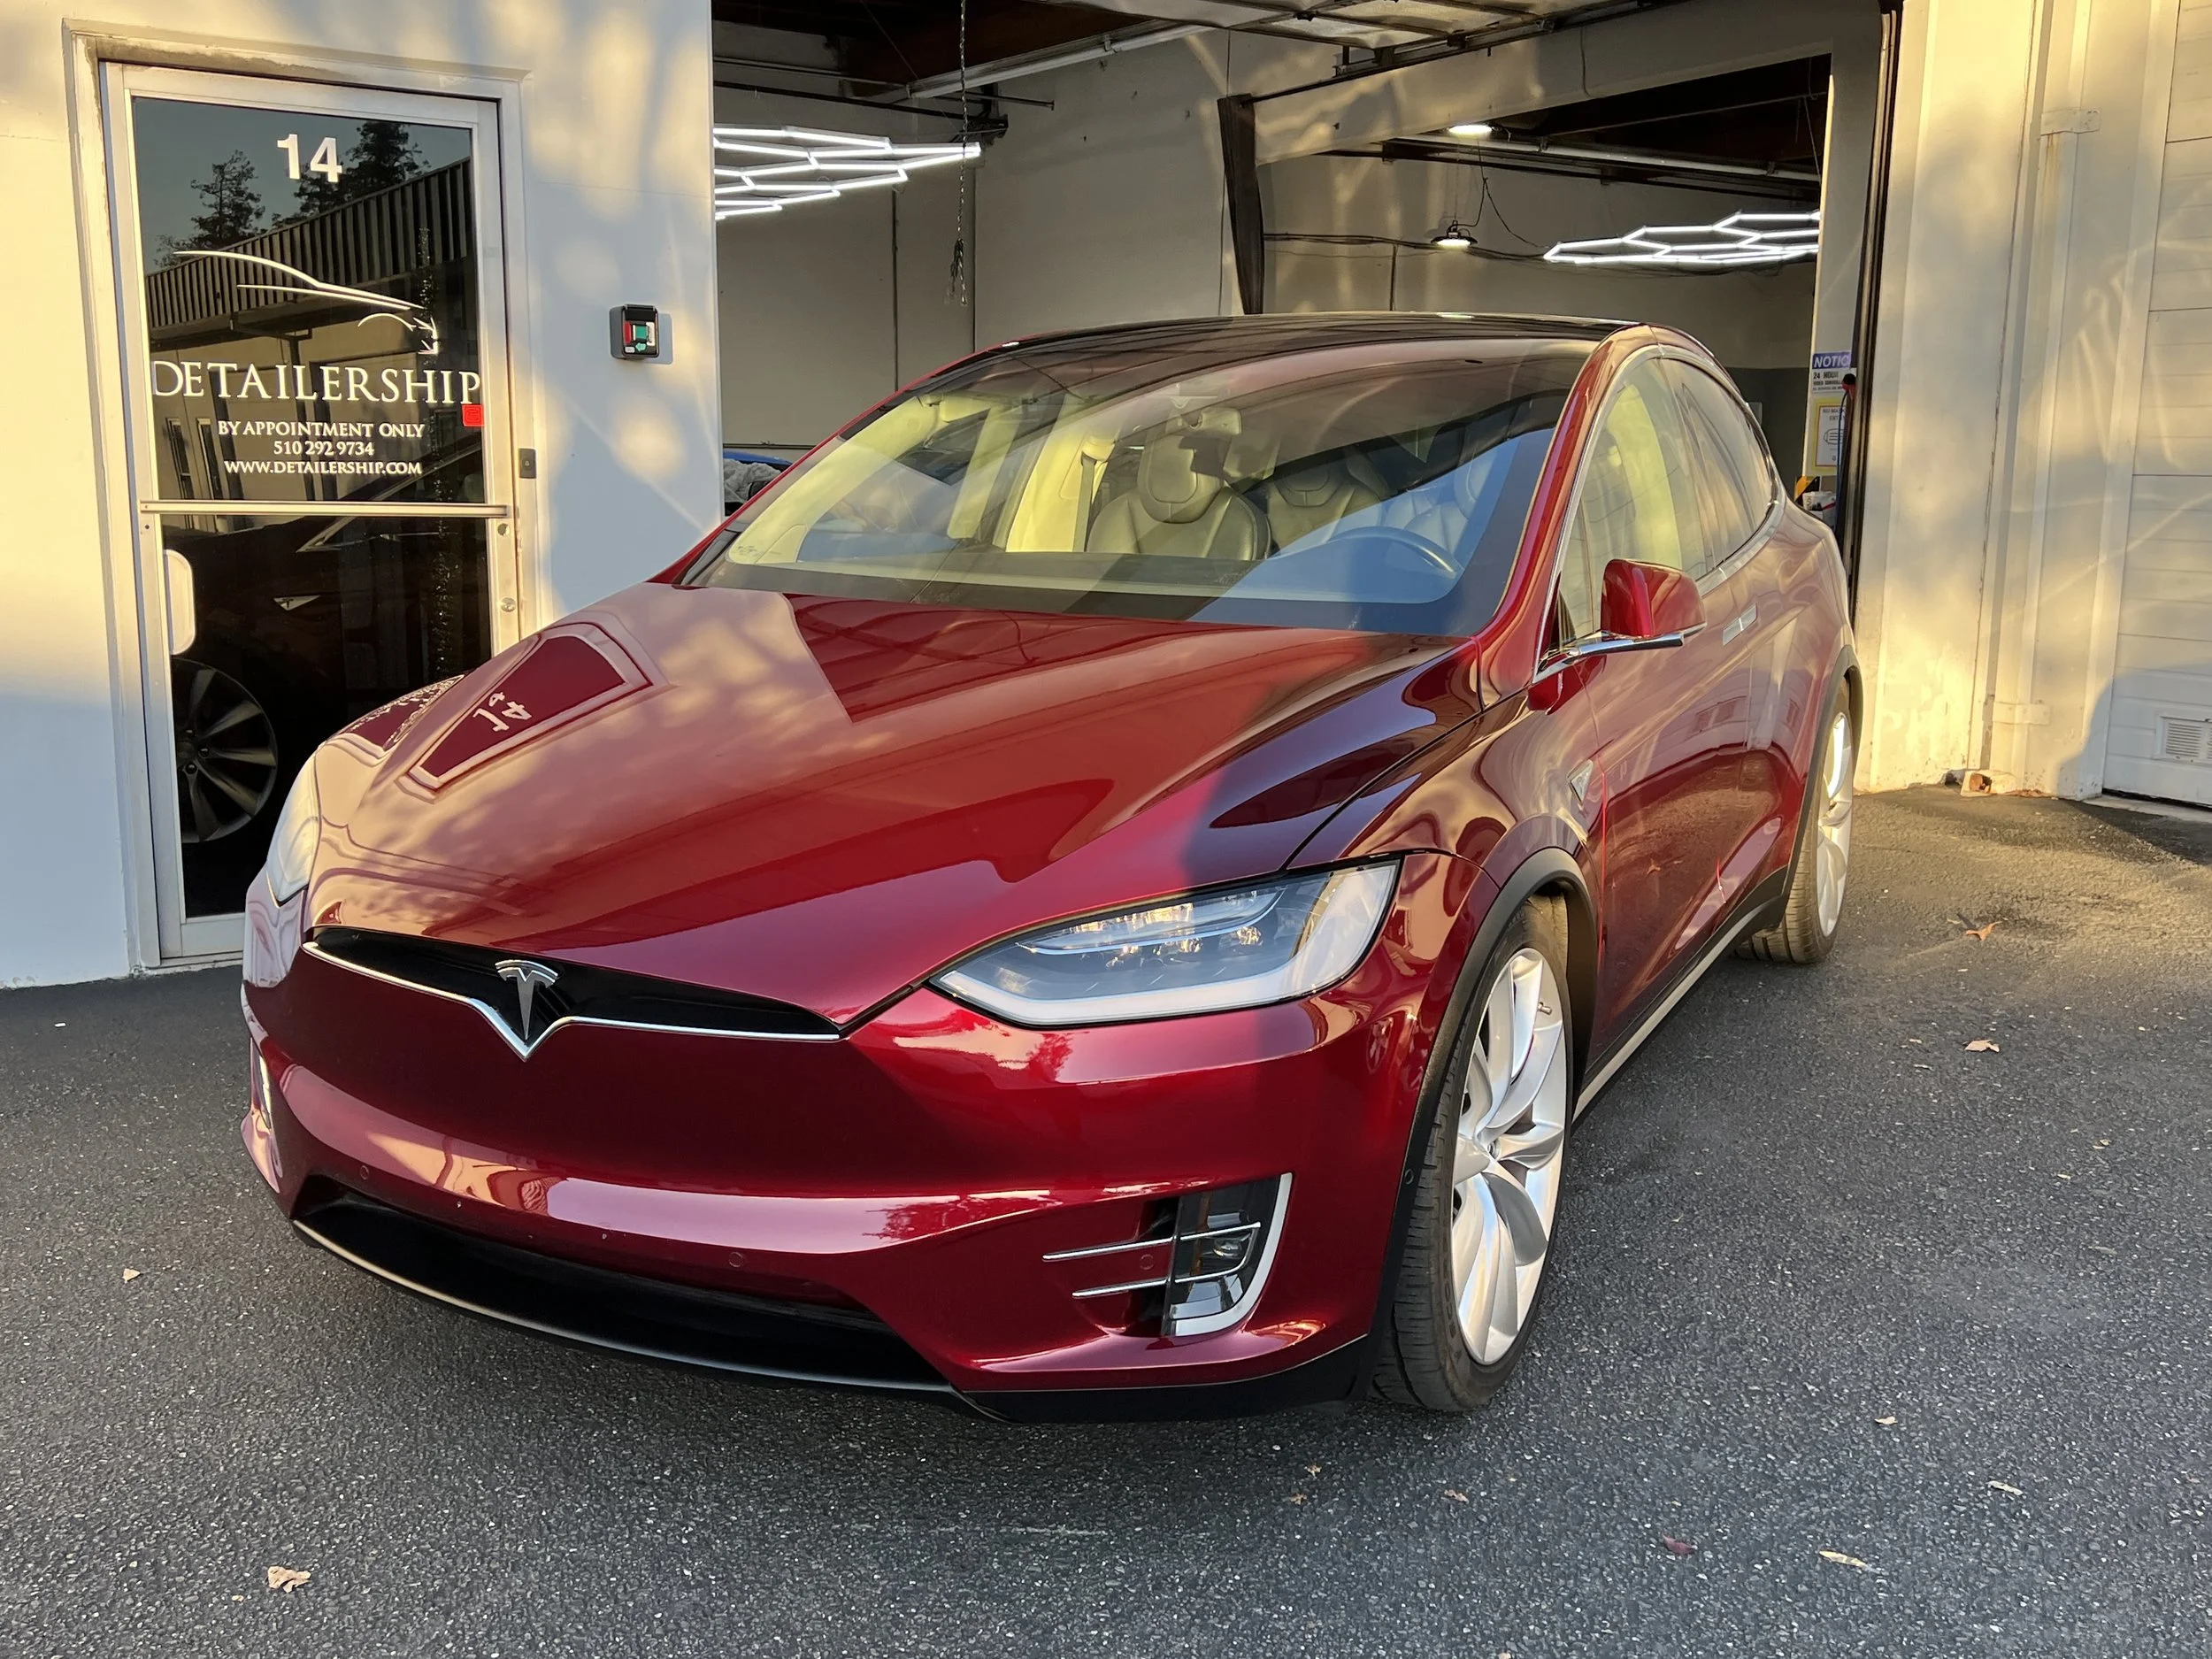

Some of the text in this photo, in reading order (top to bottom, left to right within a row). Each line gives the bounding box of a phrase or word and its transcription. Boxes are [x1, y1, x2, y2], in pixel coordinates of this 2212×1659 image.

[277, 134, 342, 182] 14
[1814, 355, 1849, 368] NOTIC
[151, 360, 480, 404] DETAILERSHIP
[218, 420, 425, 438] BY APPOINTMENT ONLY
[273, 441, 374, 456] 510 292 9734
[224, 461, 422, 474] WWW.DETAILERSHIP.COM
